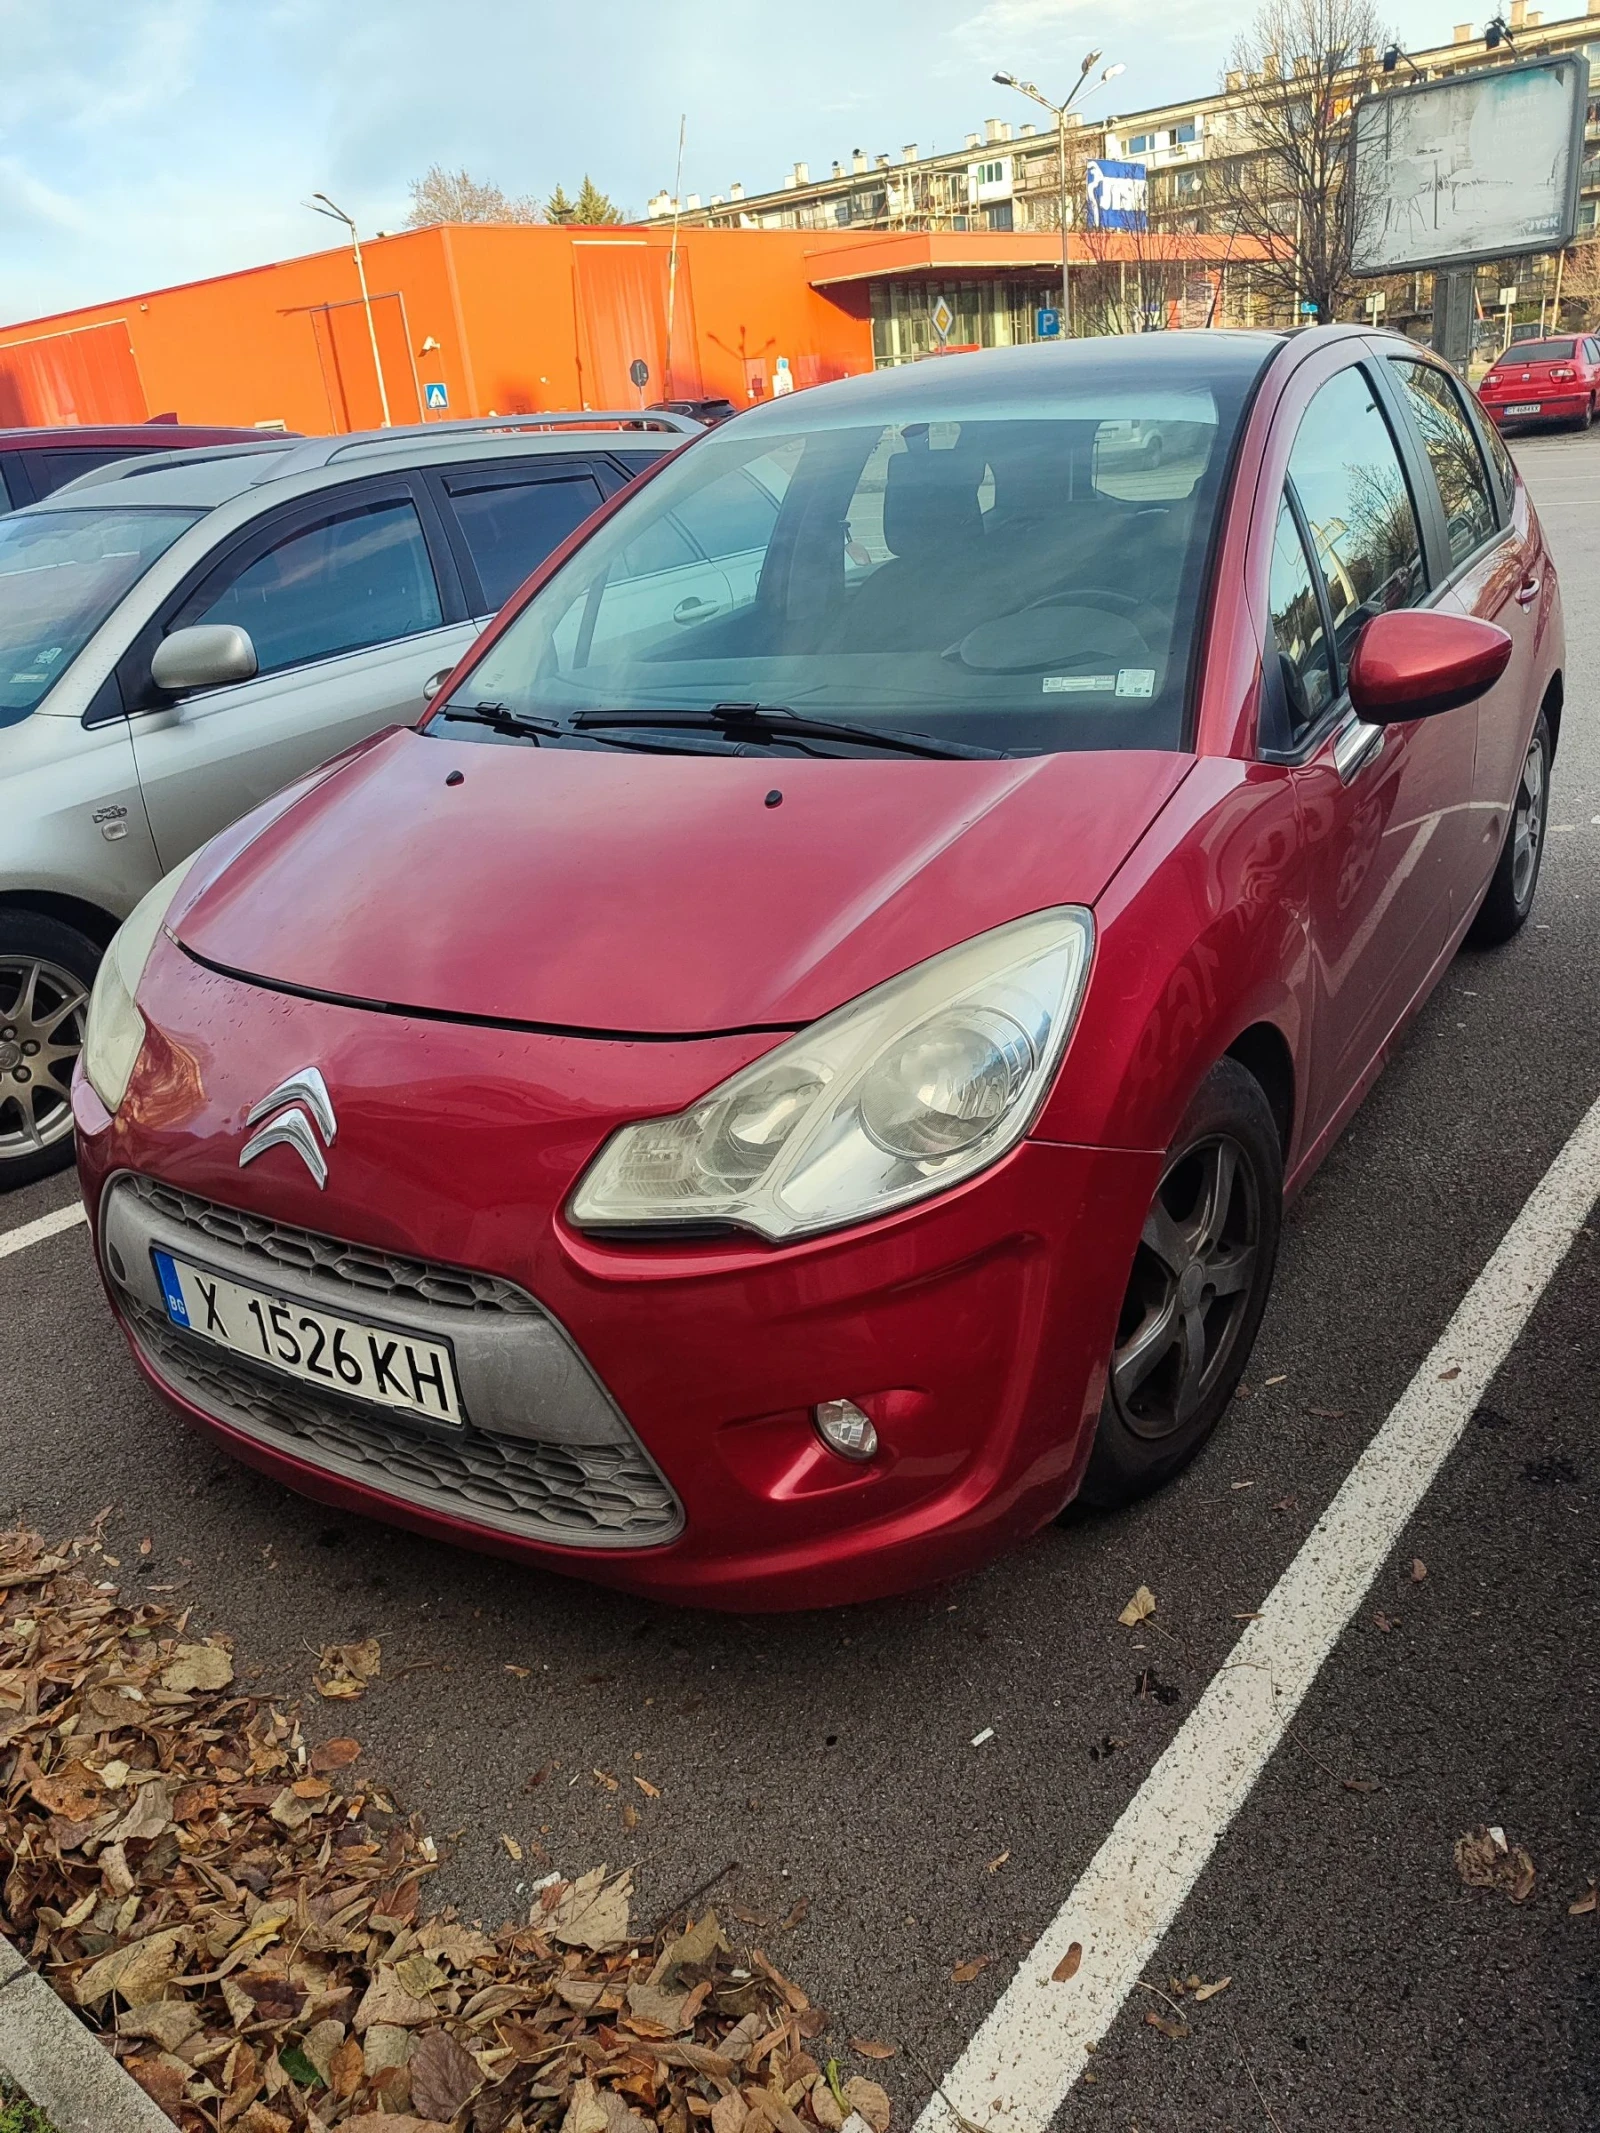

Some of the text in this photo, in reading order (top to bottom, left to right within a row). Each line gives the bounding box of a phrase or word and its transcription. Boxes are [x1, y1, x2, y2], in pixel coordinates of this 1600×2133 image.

[1527, 216, 1560, 232] JYSK
[1043, 313, 1055, 333] P
[168, 1295, 186, 1315] BG
[193, 1274, 230, 1339] X
[248, 1298, 363, 1386] 1526
